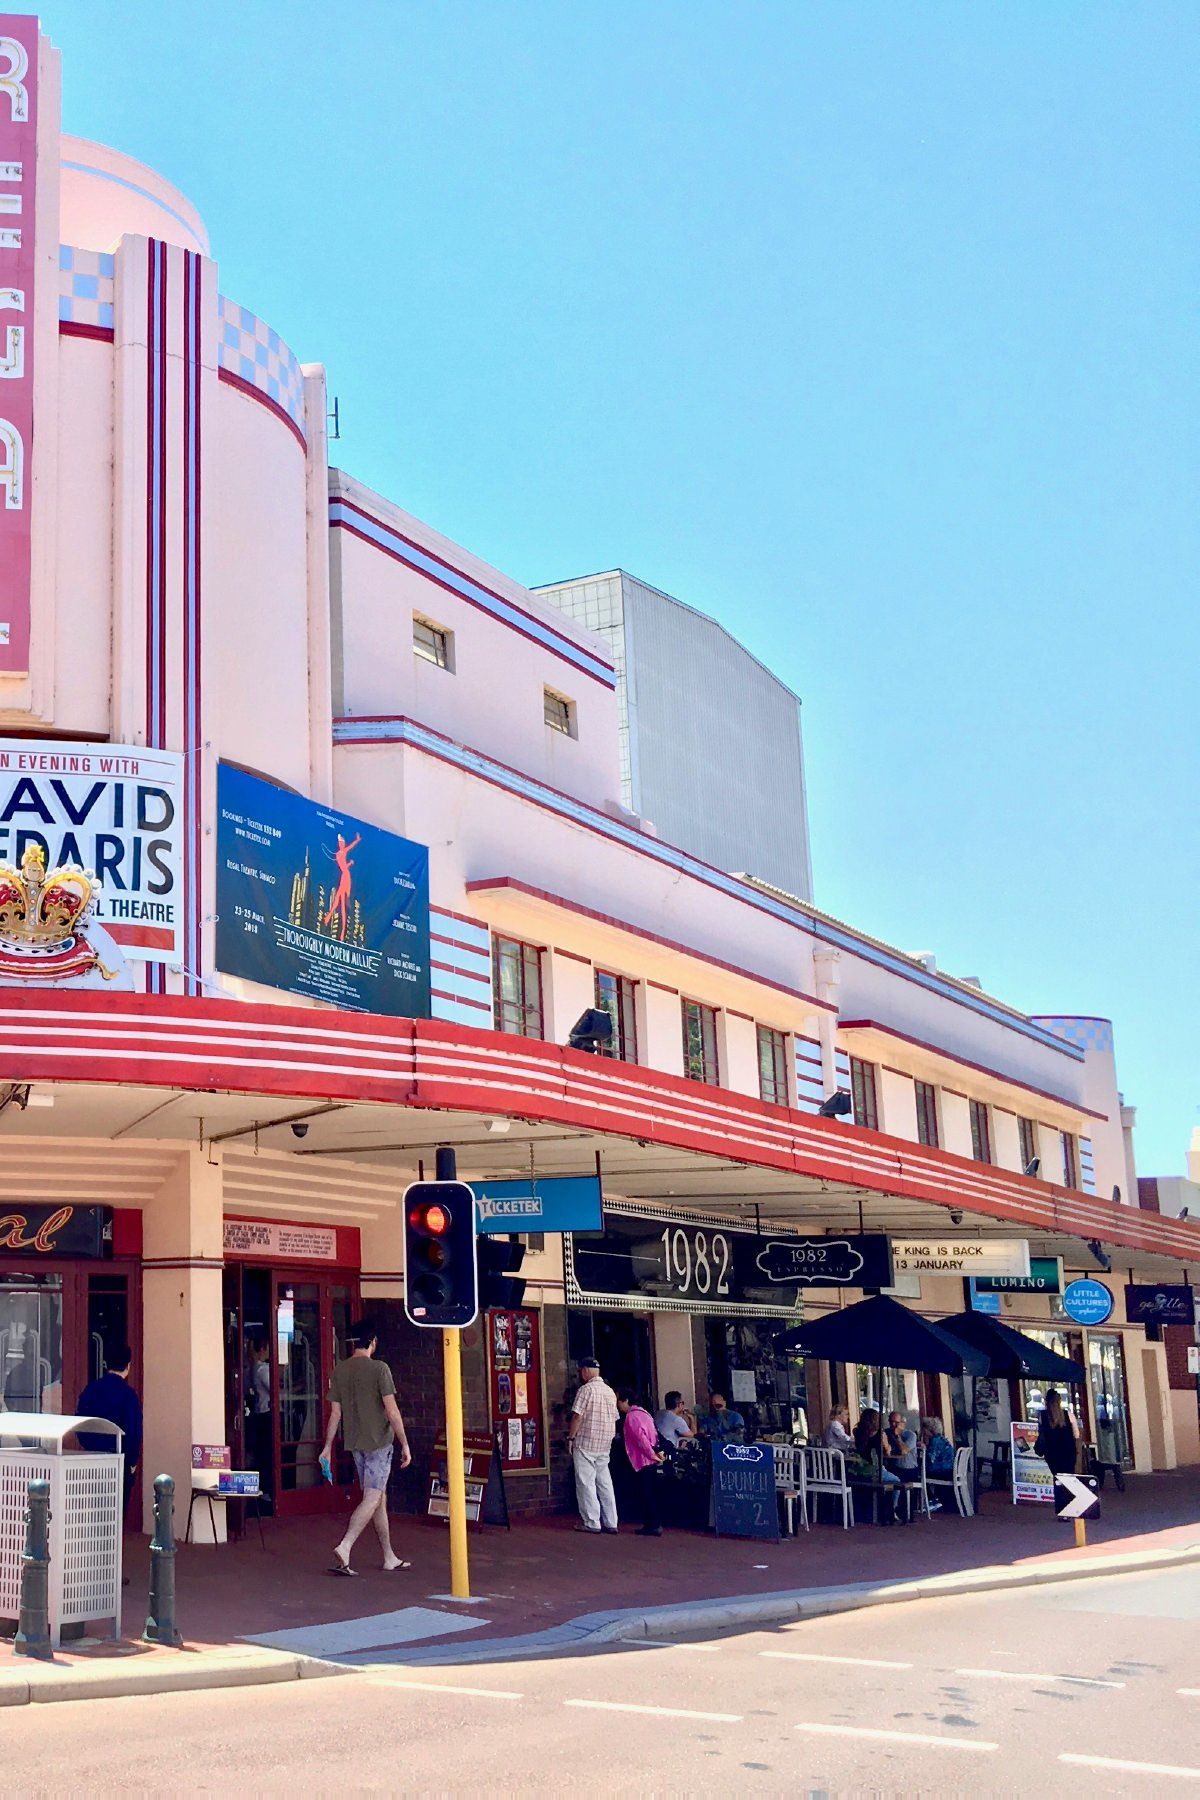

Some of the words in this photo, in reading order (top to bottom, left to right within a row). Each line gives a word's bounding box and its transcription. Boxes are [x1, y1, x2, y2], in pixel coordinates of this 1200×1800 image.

[18, 754, 91, 772] EVENING
[99, 759, 139, 775] WITH
[109, 898, 175, 923] THEATRE
[234, 905, 252, 919] 23-25
[244, 922, 258, 934] 2018
[283, 927, 323, 955] THOROUGHLY
[324, 943, 351, 964] MODERN
[482, 1200, 540, 1214] TICKETEK
[790, 1249, 827, 1263] 1982
[904, 1247, 930, 1255] KING
[938, 1247, 948, 1255] IS
[953, 1247, 984, 1255] BACK
[661, 1227, 729, 1295] 1982
[913, 1260, 964, 1269] JANUARY
[991, 1276, 1045, 1288] LUMINO
[1073, 1290, 1100, 1298] LITTLE
[1065, 1299, 1109, 1307] CULTURES
[445, 1338, 450, 1346] 3
[719, 1470, 768, 1493] BRUNCH
